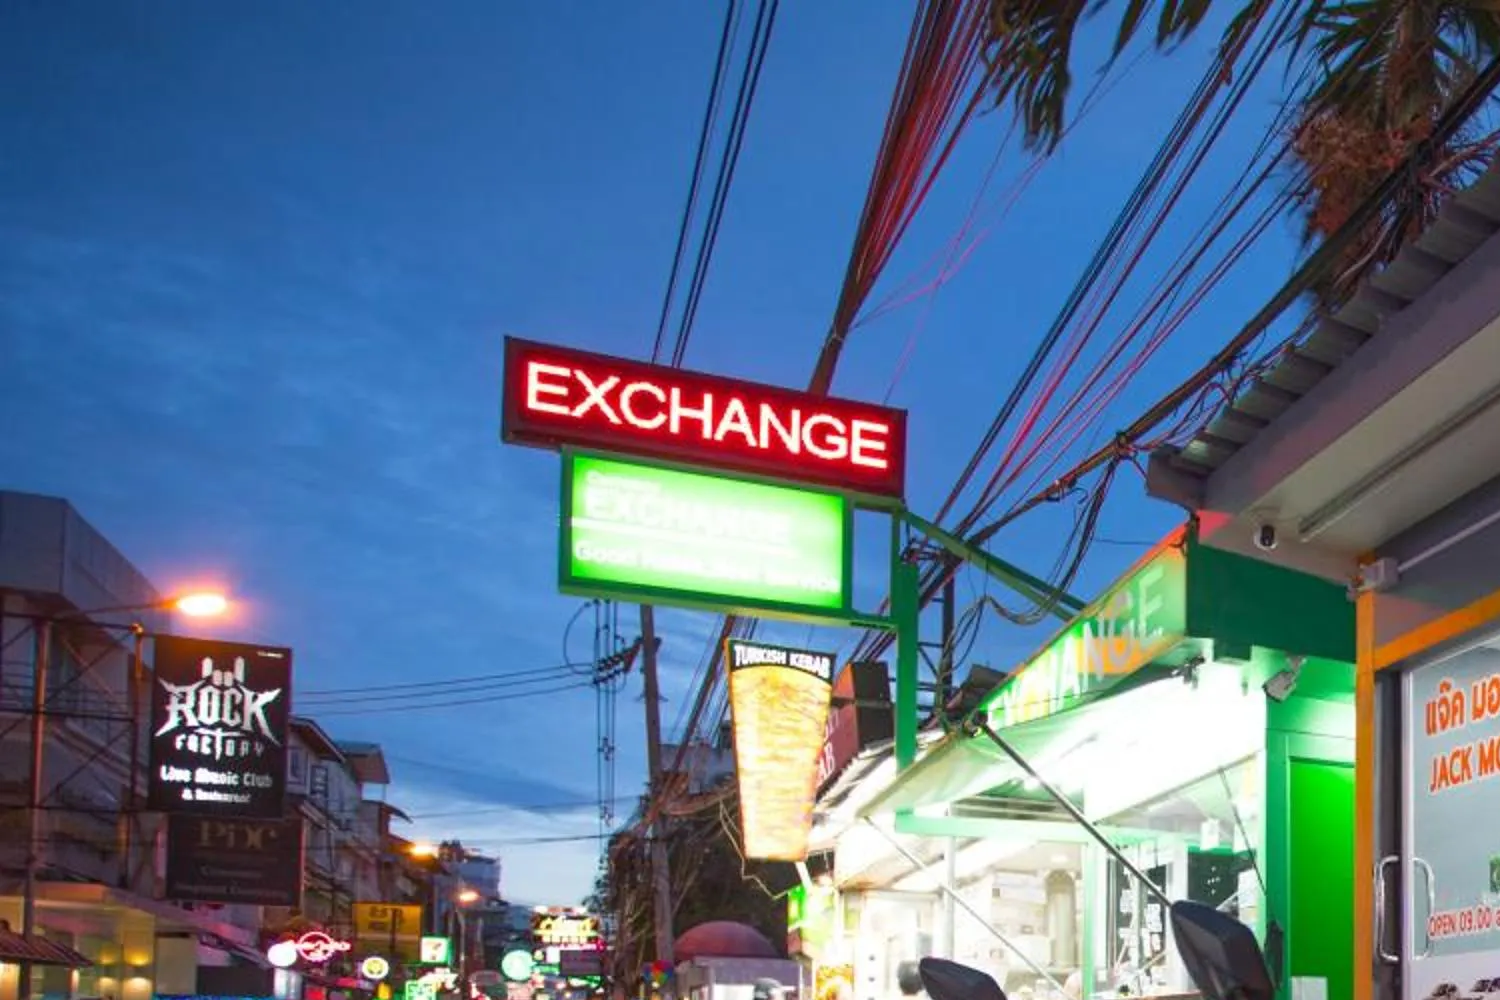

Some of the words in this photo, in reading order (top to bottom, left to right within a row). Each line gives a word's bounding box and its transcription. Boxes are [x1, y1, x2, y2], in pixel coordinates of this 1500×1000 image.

[526, 361, 890, 469] EXCHANGE
[734, 644, 787, 667] TURKISH
[789, 652, 831, 679] KEBAB
[155, 677, 281, 747] ROCK
[175, 728, 264, 761] FACTORY
[1430, 746, 1473, 793] JACK
[1429, 913, 1456, 937] OPEN
[1459, 907, 1492, 932] 09.00
